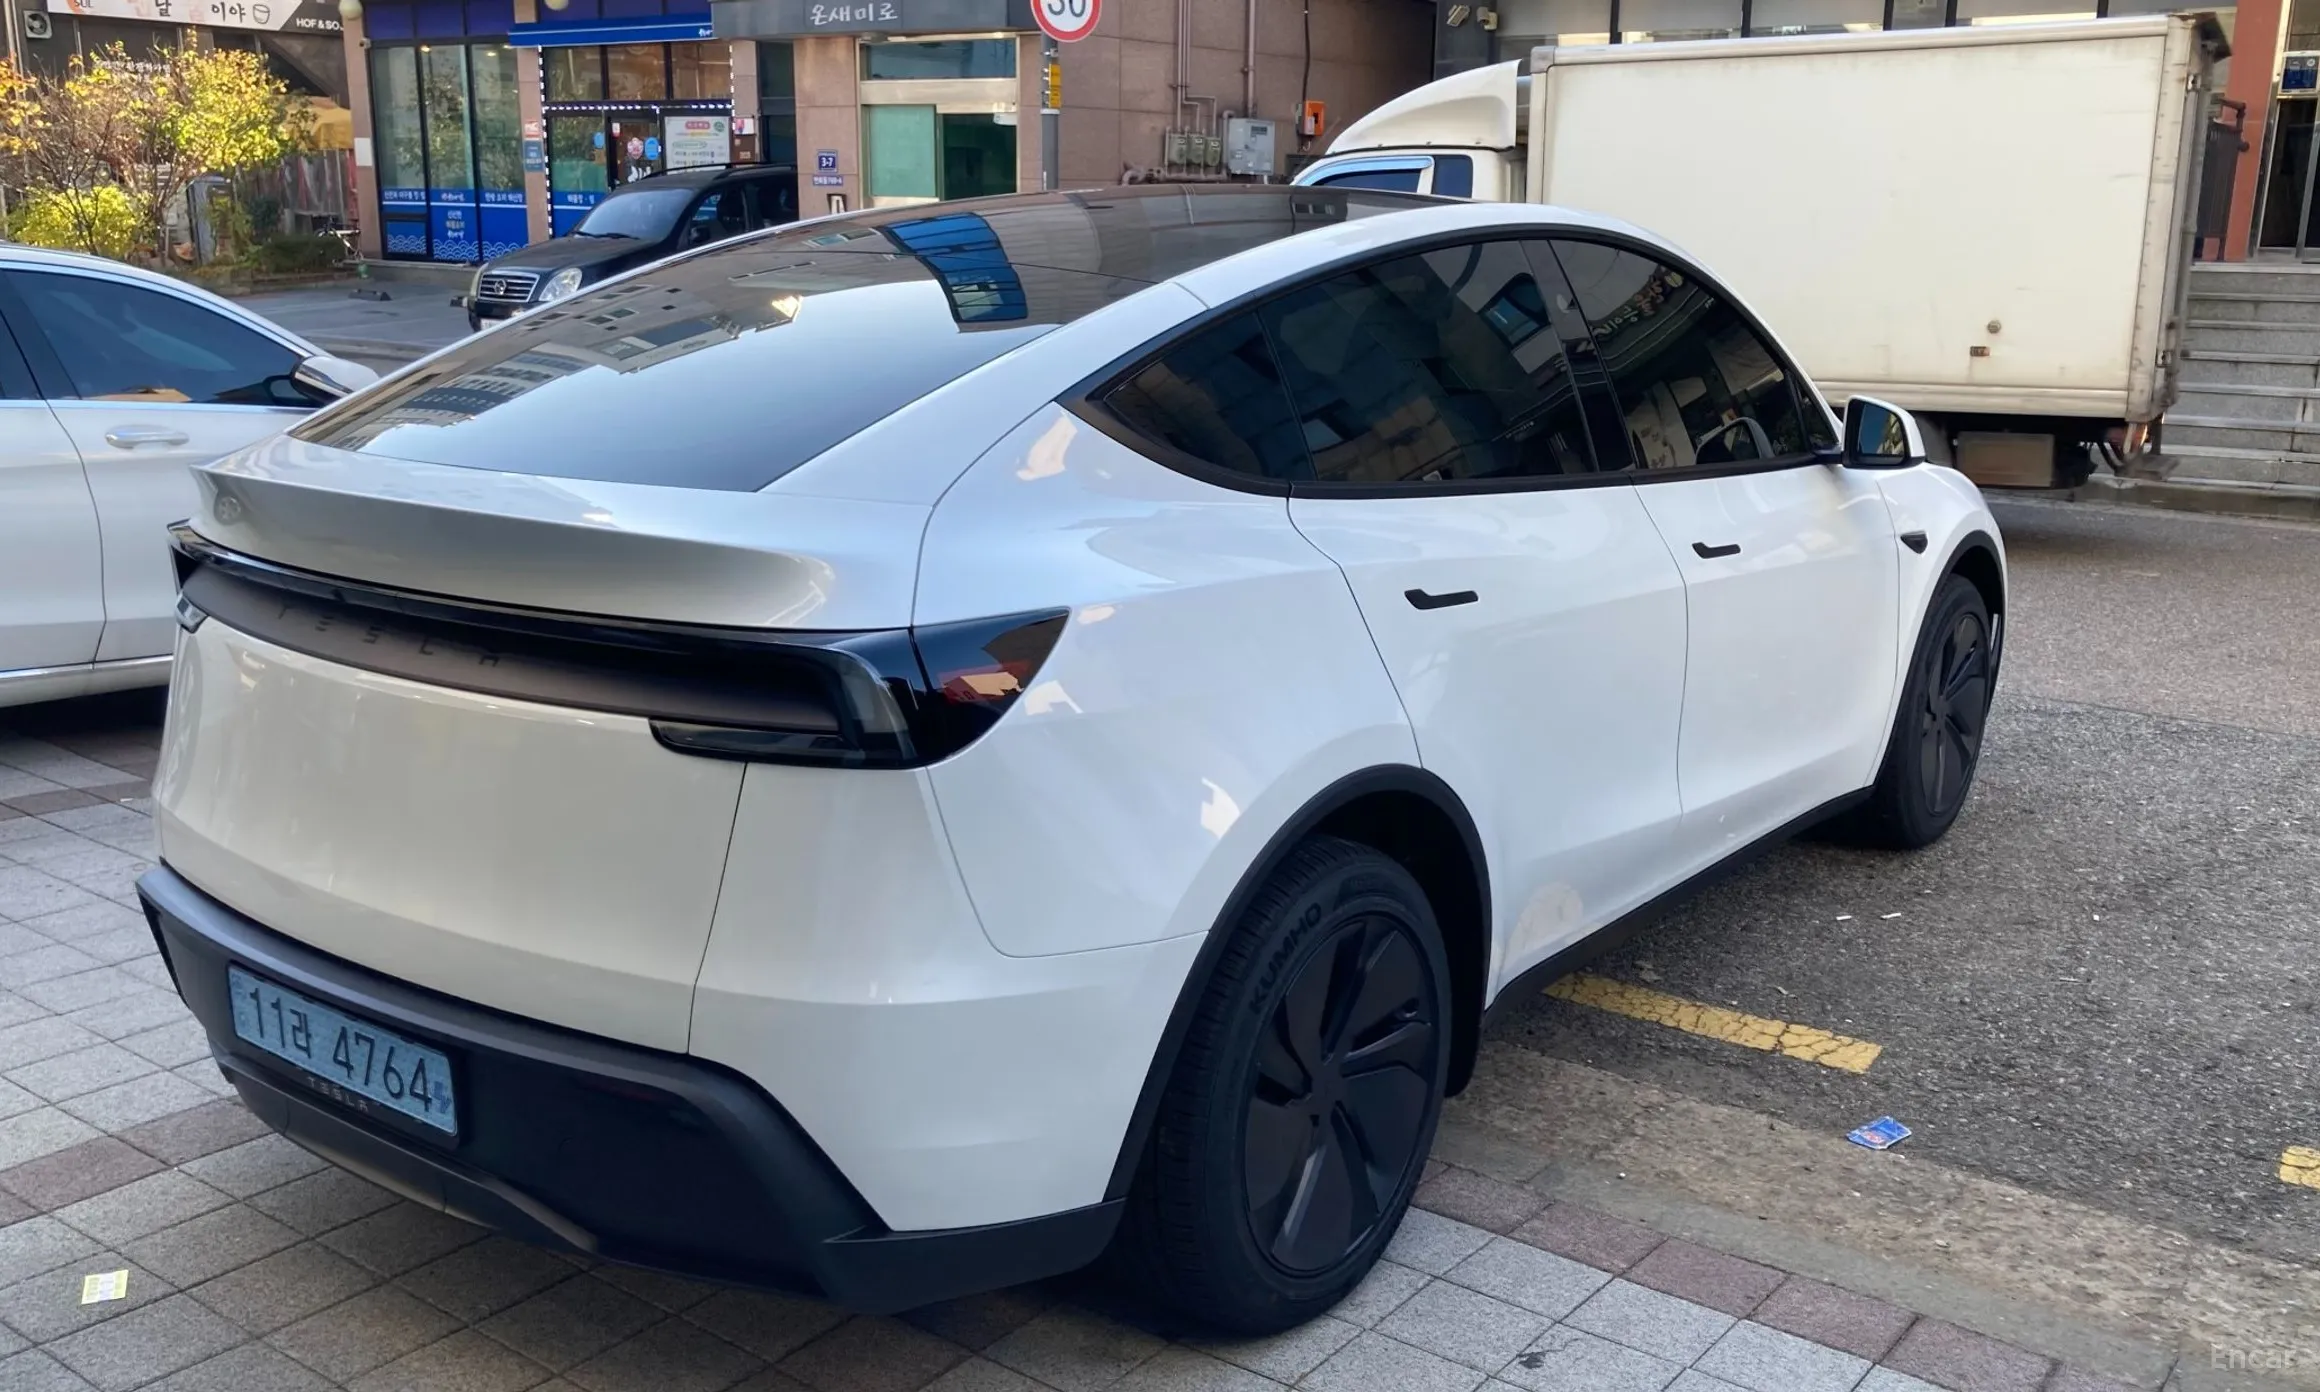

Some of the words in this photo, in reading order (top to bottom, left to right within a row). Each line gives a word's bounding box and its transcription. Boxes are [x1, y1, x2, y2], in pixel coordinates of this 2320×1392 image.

[211, 2, 246, 23] 이야
[296, 18, 317, 28] HOF
[810, 2, 899, 26] 온새미로
[276, 605, 500, 666] TESLA
[1248, 902, 1321, 1015] KUMHO
[249, 987, 312, 1059] 11라
[332, 1025, 433, 1112] 4764
[306, 1076, 369, 1112] TESLA
